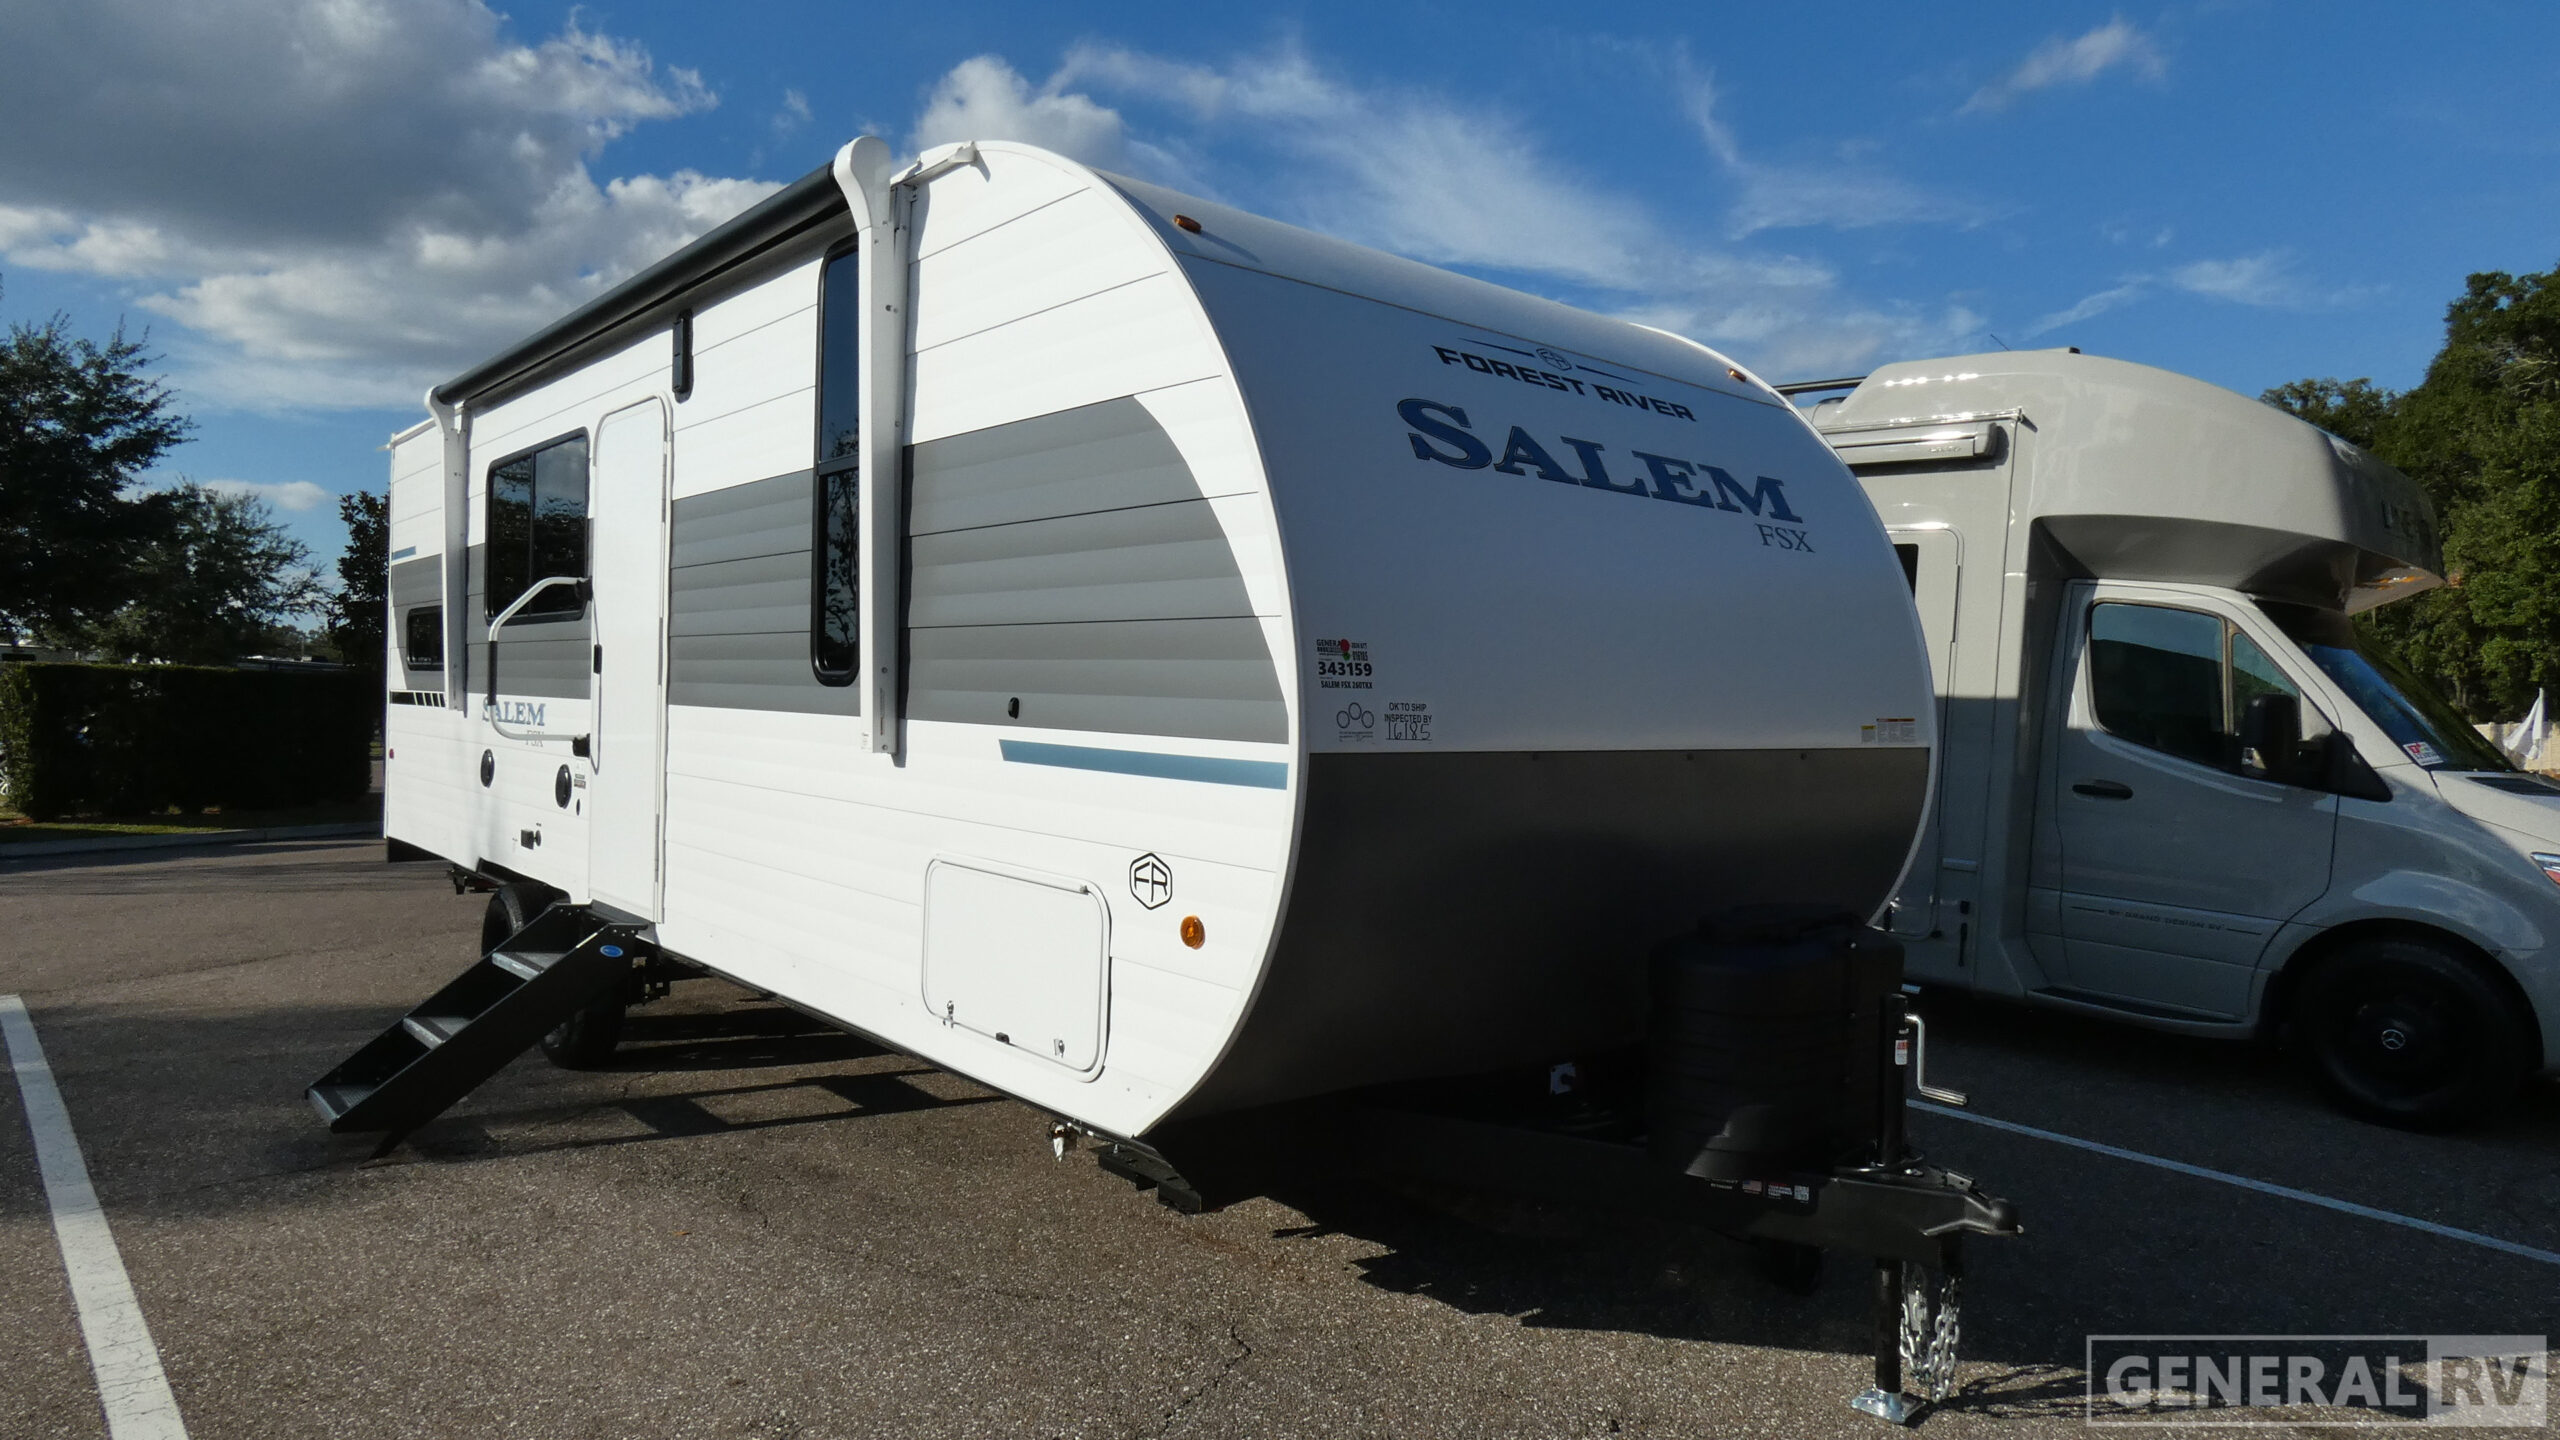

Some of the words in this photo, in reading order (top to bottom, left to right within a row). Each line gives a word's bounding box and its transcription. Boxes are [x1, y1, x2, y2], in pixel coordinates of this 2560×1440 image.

[1430, 345, 1585, 395] FOREST
[1591, 383, 1697, 421] RIVER
[1397, 398, 1803, 523] SALEM
[1755, 523, 1815, 553] FSX
[1318, 662, 1372, 676] 343159
[1384, 713, 1421, 723] INSPECTED
[1423, 715, 1432, 723] BY
[1389, 702, 1399, 711] OK
[1401, 702, 1409, 711] TO
[1411, 703, 1427, 712] SHIP
